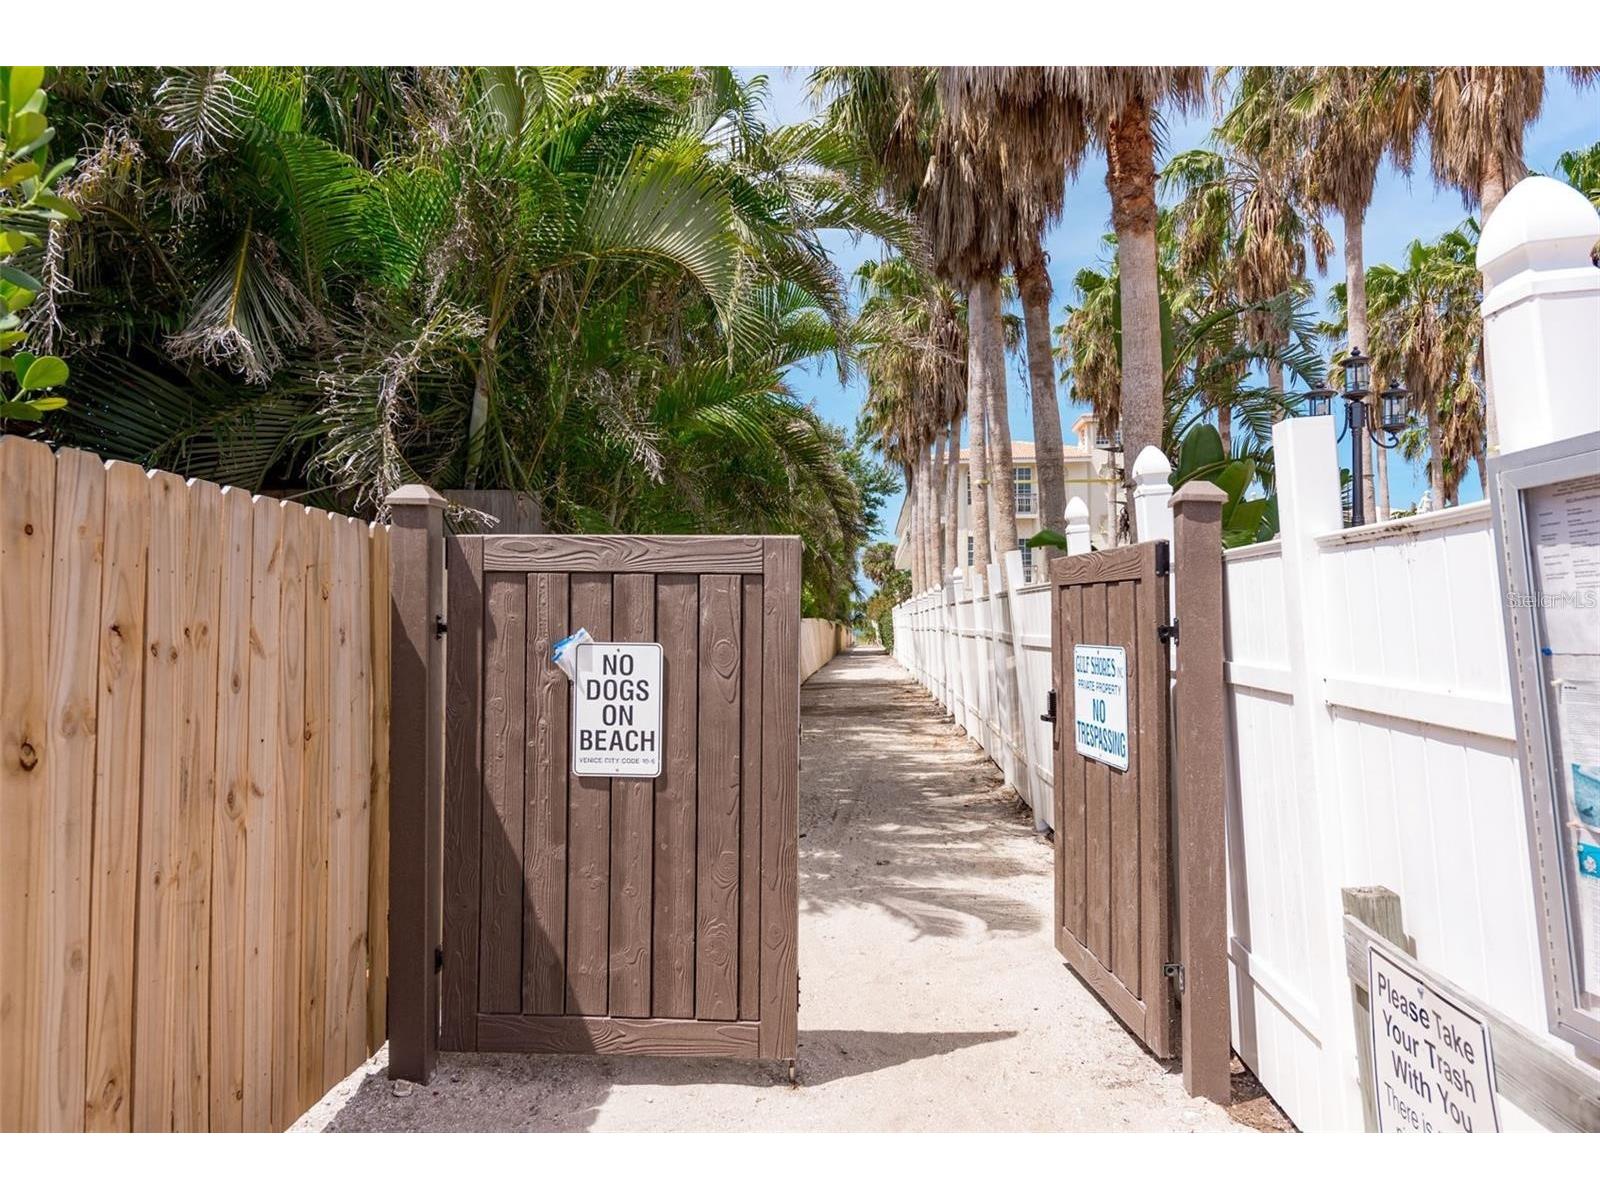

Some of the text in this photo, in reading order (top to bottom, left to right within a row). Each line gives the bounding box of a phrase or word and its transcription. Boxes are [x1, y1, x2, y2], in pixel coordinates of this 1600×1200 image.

[603, 654, 634, 676] NO
[1076, 655, 1089, 673] GULF
[1091, 656, 1116, 677] SHORES
[587, 679, 649, 701] DOGS
[1078, 679, 1121, 696] PRIVATE PROPERTY
[602, 704, 633, 726] ON
[1092, 698, 1106, 723] NO
[580, 730, 655, 751] BEACH
[1077, 720, 1126, 758] TRESPASSING
[1377, 972, 1475, 1065] Please Take
[1382, 1009, 1476, 1103] Your Trash
[1391, 1050, 1473, 1133] With You
[1384, 1081, 1419, 1130] There
